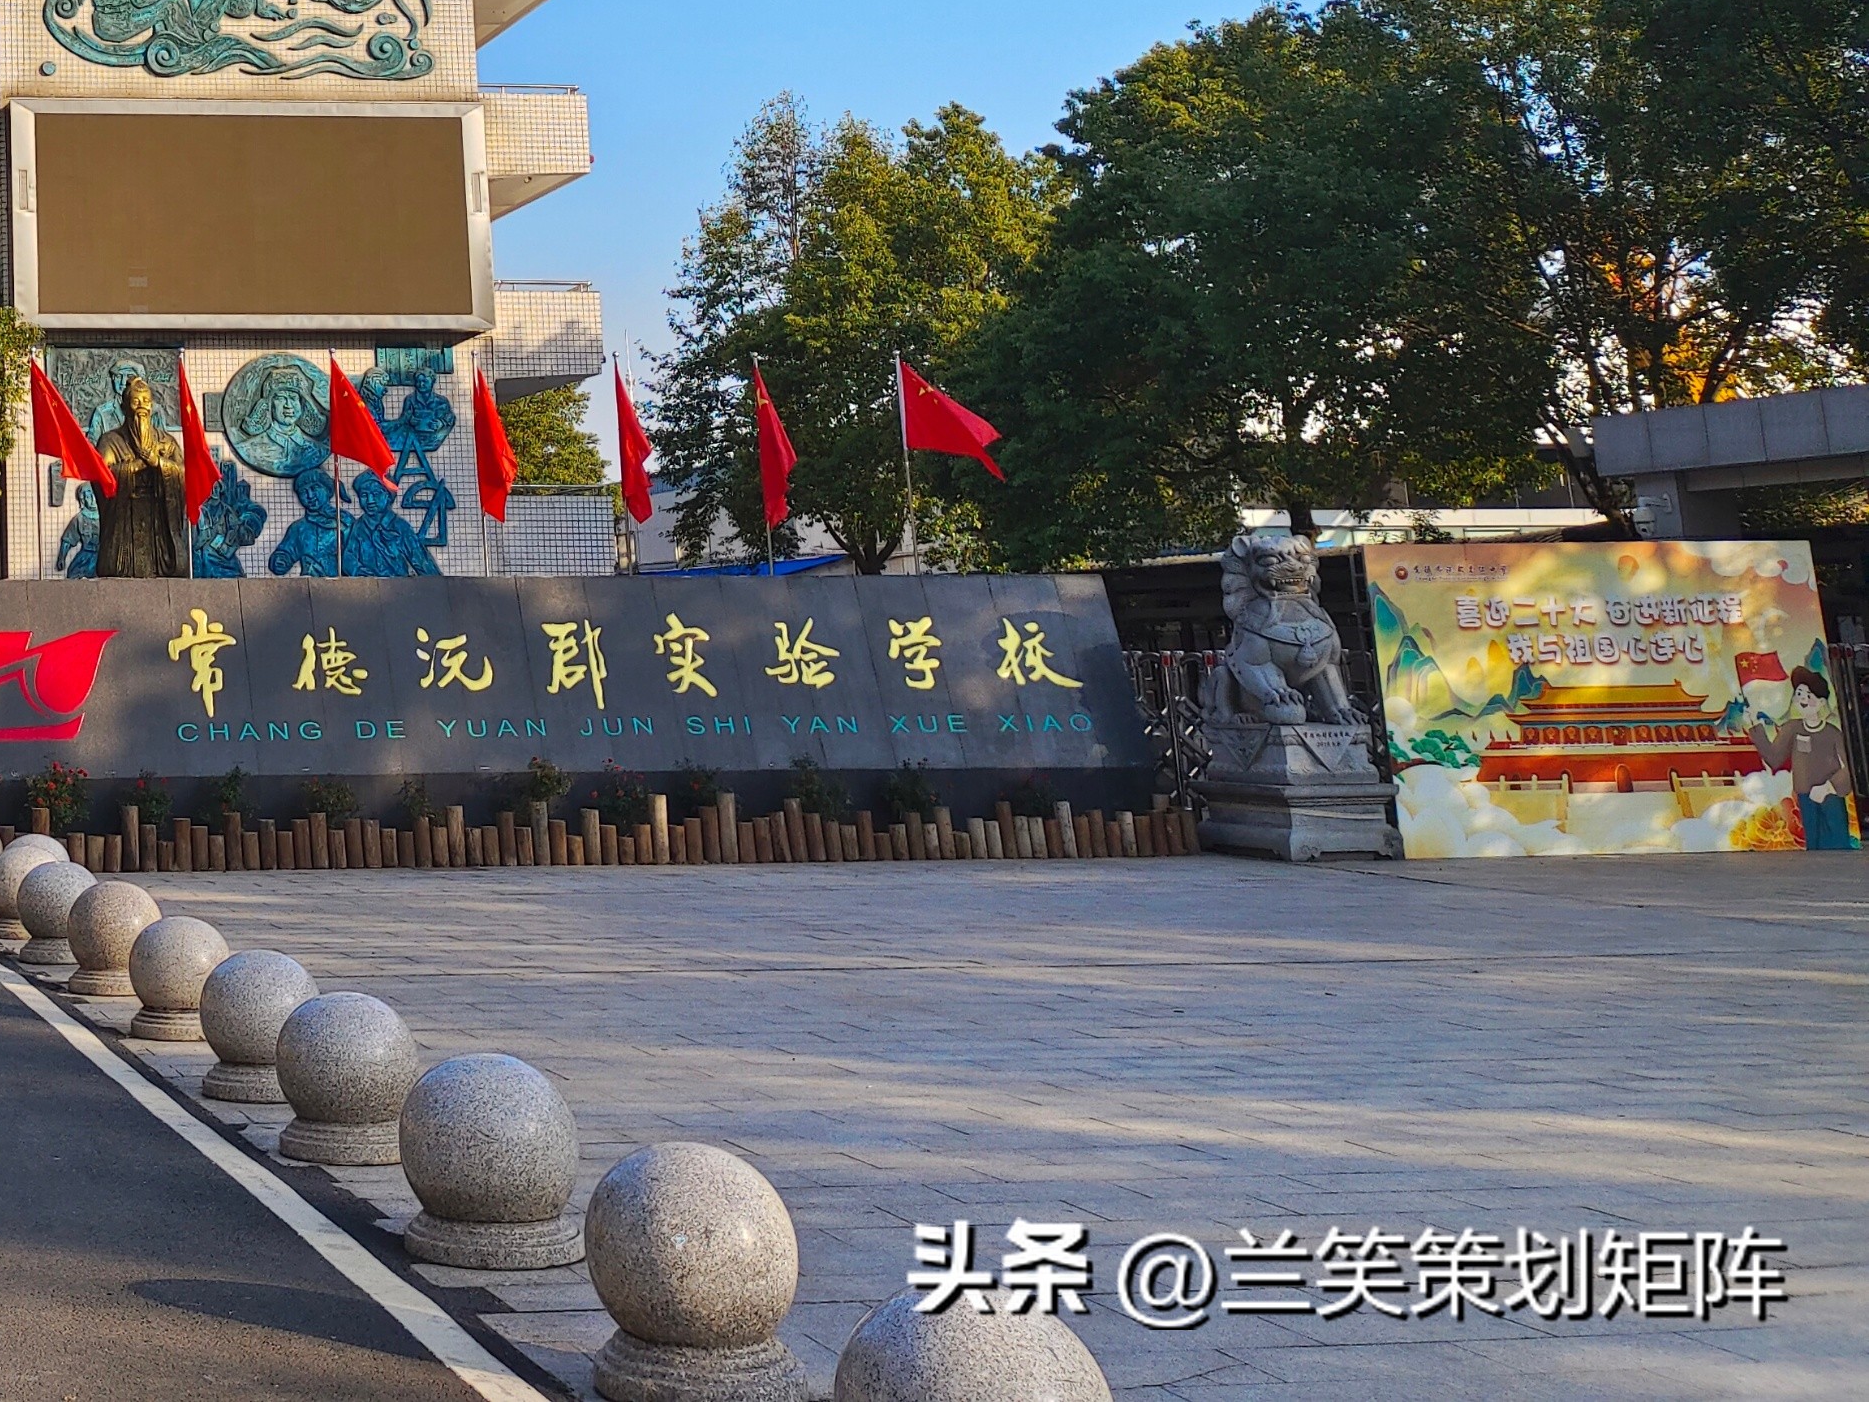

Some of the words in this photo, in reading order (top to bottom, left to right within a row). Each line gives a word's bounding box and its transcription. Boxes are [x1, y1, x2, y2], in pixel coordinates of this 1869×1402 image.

[1455, 595, 1597, 629] 喜迎二十大
[1605, 594, 1745, 626] 奋进新征程
[167, 608, 1085, 718] 常德沅郡实验学校
[1506, 632, 1704, 665] 我与祖国心连心
[176, 721, 323, 743] CHANG
[355, 720, 407, 740] DE
[436, 719, 547, 739] YUAN
[579, 716, 654, 737] JUN
[686, 715, 752, 736] SHI
[781, 715, 859, 735] YAN
[890, 713, 967, 734] XUE
[998, 713, 1094, 733] XIAO
